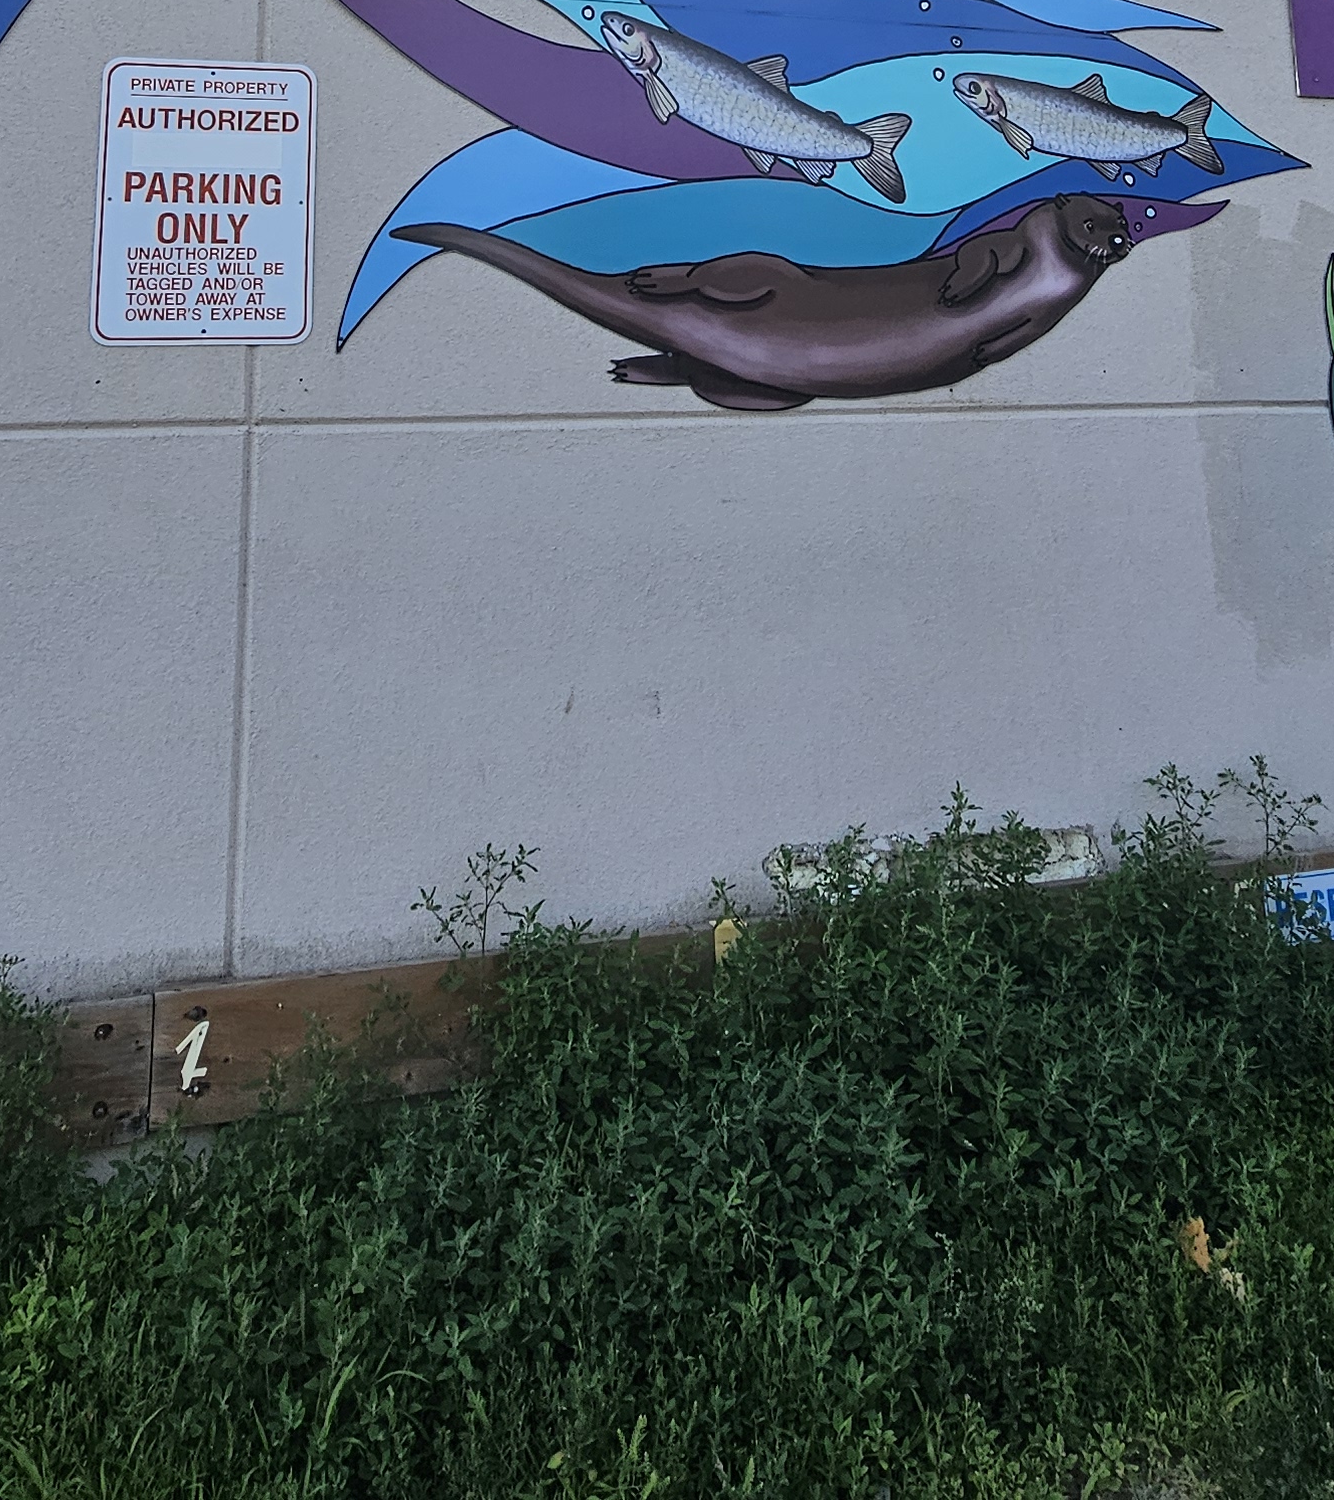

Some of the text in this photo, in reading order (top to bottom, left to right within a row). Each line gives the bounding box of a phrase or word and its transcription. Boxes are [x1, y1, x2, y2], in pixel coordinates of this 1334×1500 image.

[130, 78, 288, 95] PRIVATE PROPERTY
[117, 107, 300, 132] AUTHORIZED
[124, 171, 281, 205] PARKING
[157, 212, 249, 244] ONLY
[127, 248, 257, 261] UNAUTHORIZED
[127, 263, 284, 275] VEHICLES WILL BE
[127, 278, 264, 290] TAGGED AND/OR
[126, 293, 265, 306] TOWED AWAY AT
[125, 308, 286, 321] OWNER'S EXPENSE
[175, 1021, 209, 1090] 1
